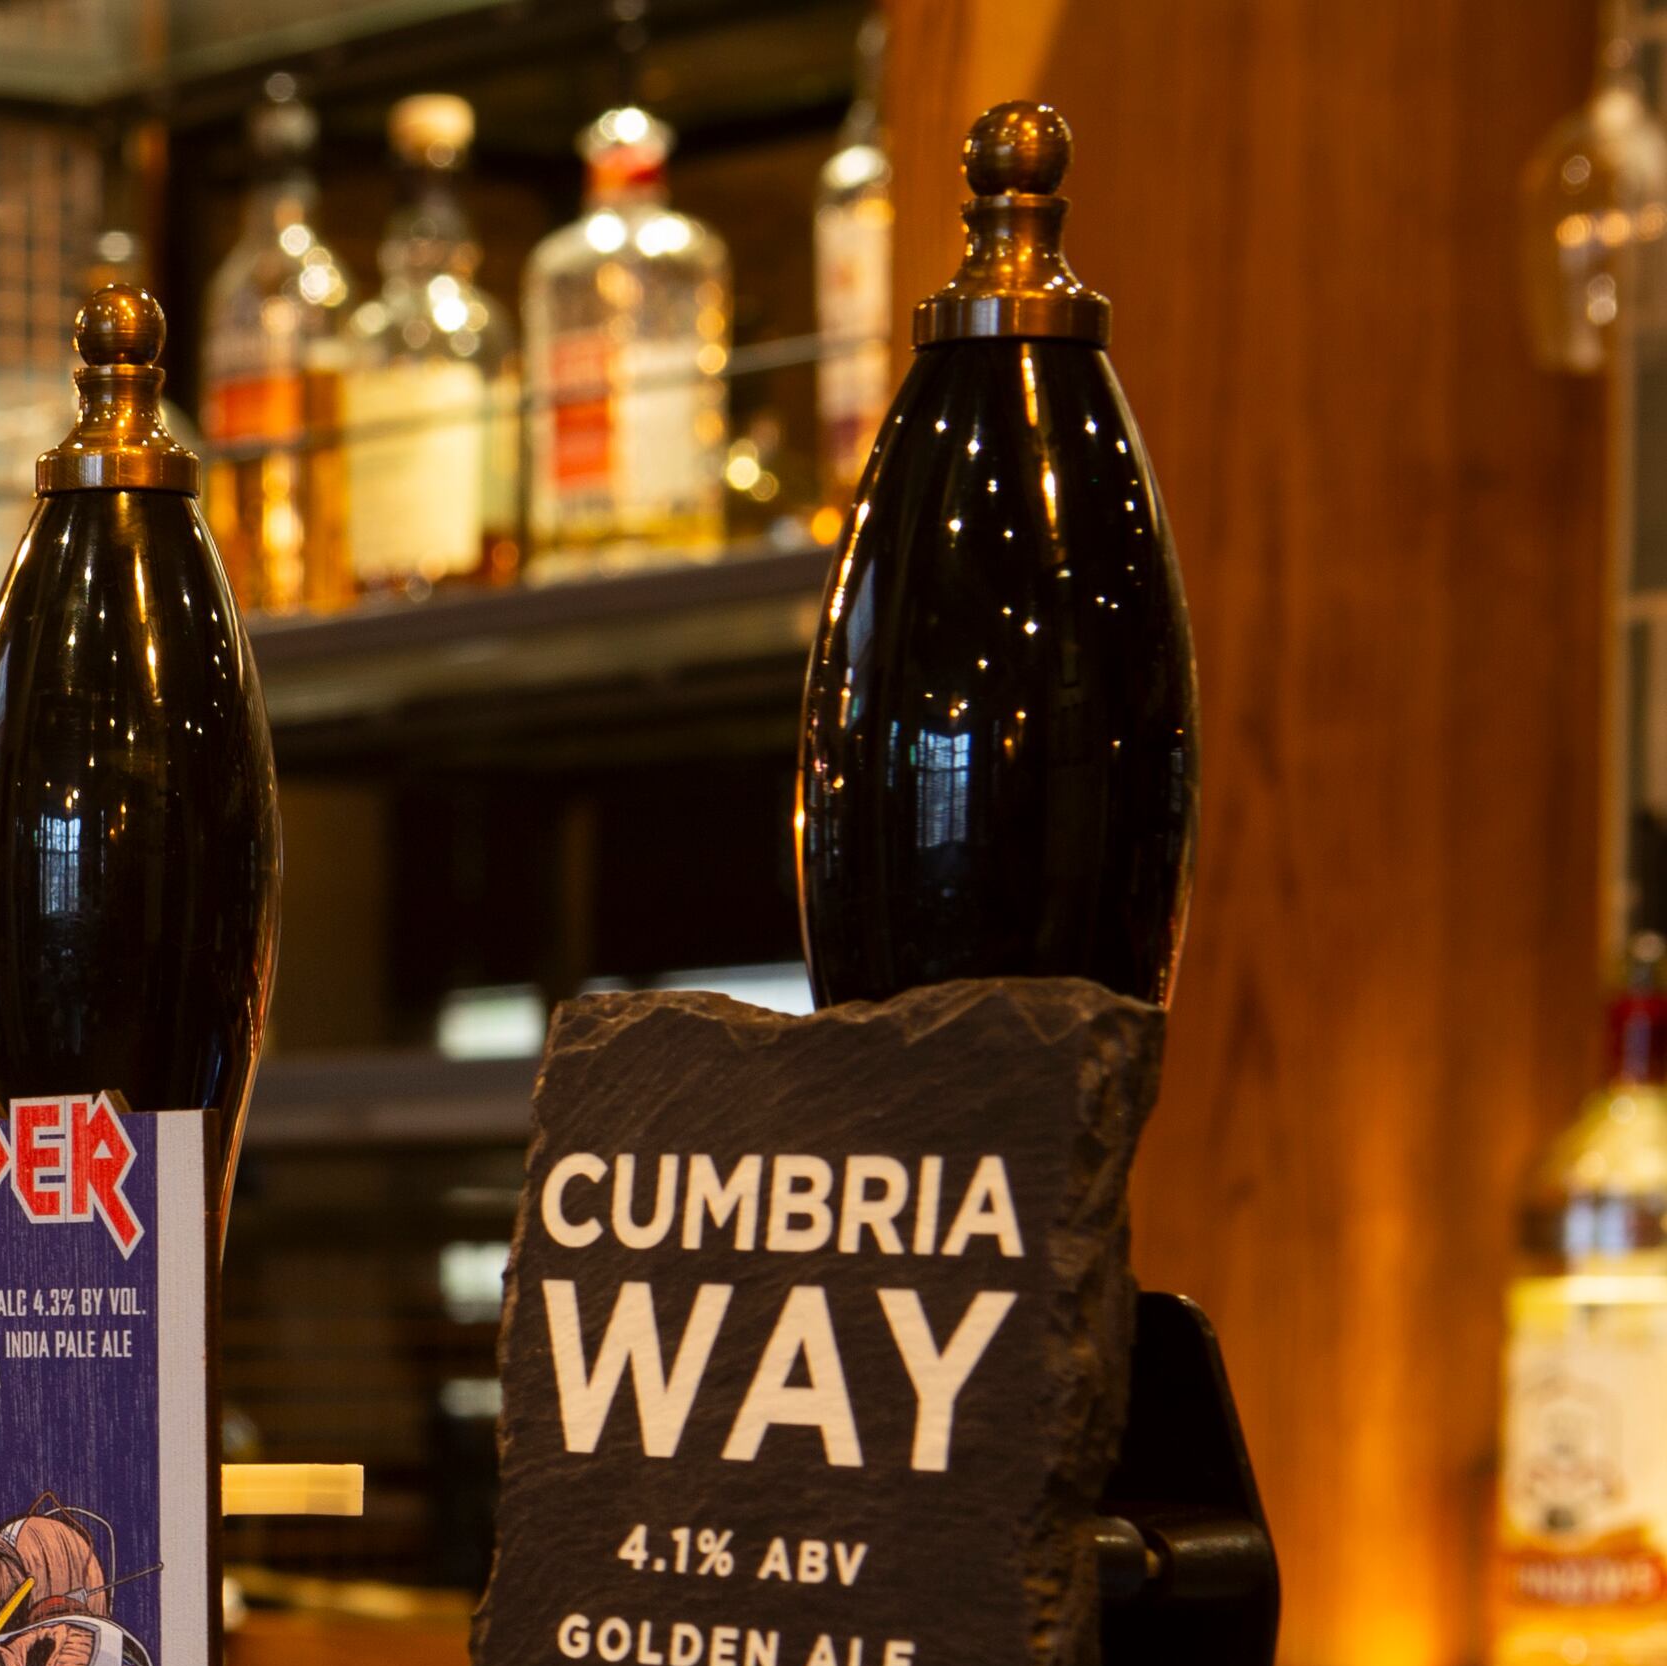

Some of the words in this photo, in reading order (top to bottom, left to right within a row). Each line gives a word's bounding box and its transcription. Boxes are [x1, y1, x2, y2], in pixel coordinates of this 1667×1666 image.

[540, 1152, 1025, 1257] CUMBRIA
[33, 1288, 76, 1317] 4.3%
[81, 1287, 104, 1316] BY
[109, 1287, 147, 1316] VOL.
[5, 1330, 50, 1359] INDIA
[55, 1330, 96, 1359] PALE
[101, 1330, 133, 1359] ALE
[541, 1278, 1019, 1472] WAY
[617, 1524, 735, 1578] 4.1%
[757, 1537, 867, 1587] ABV
